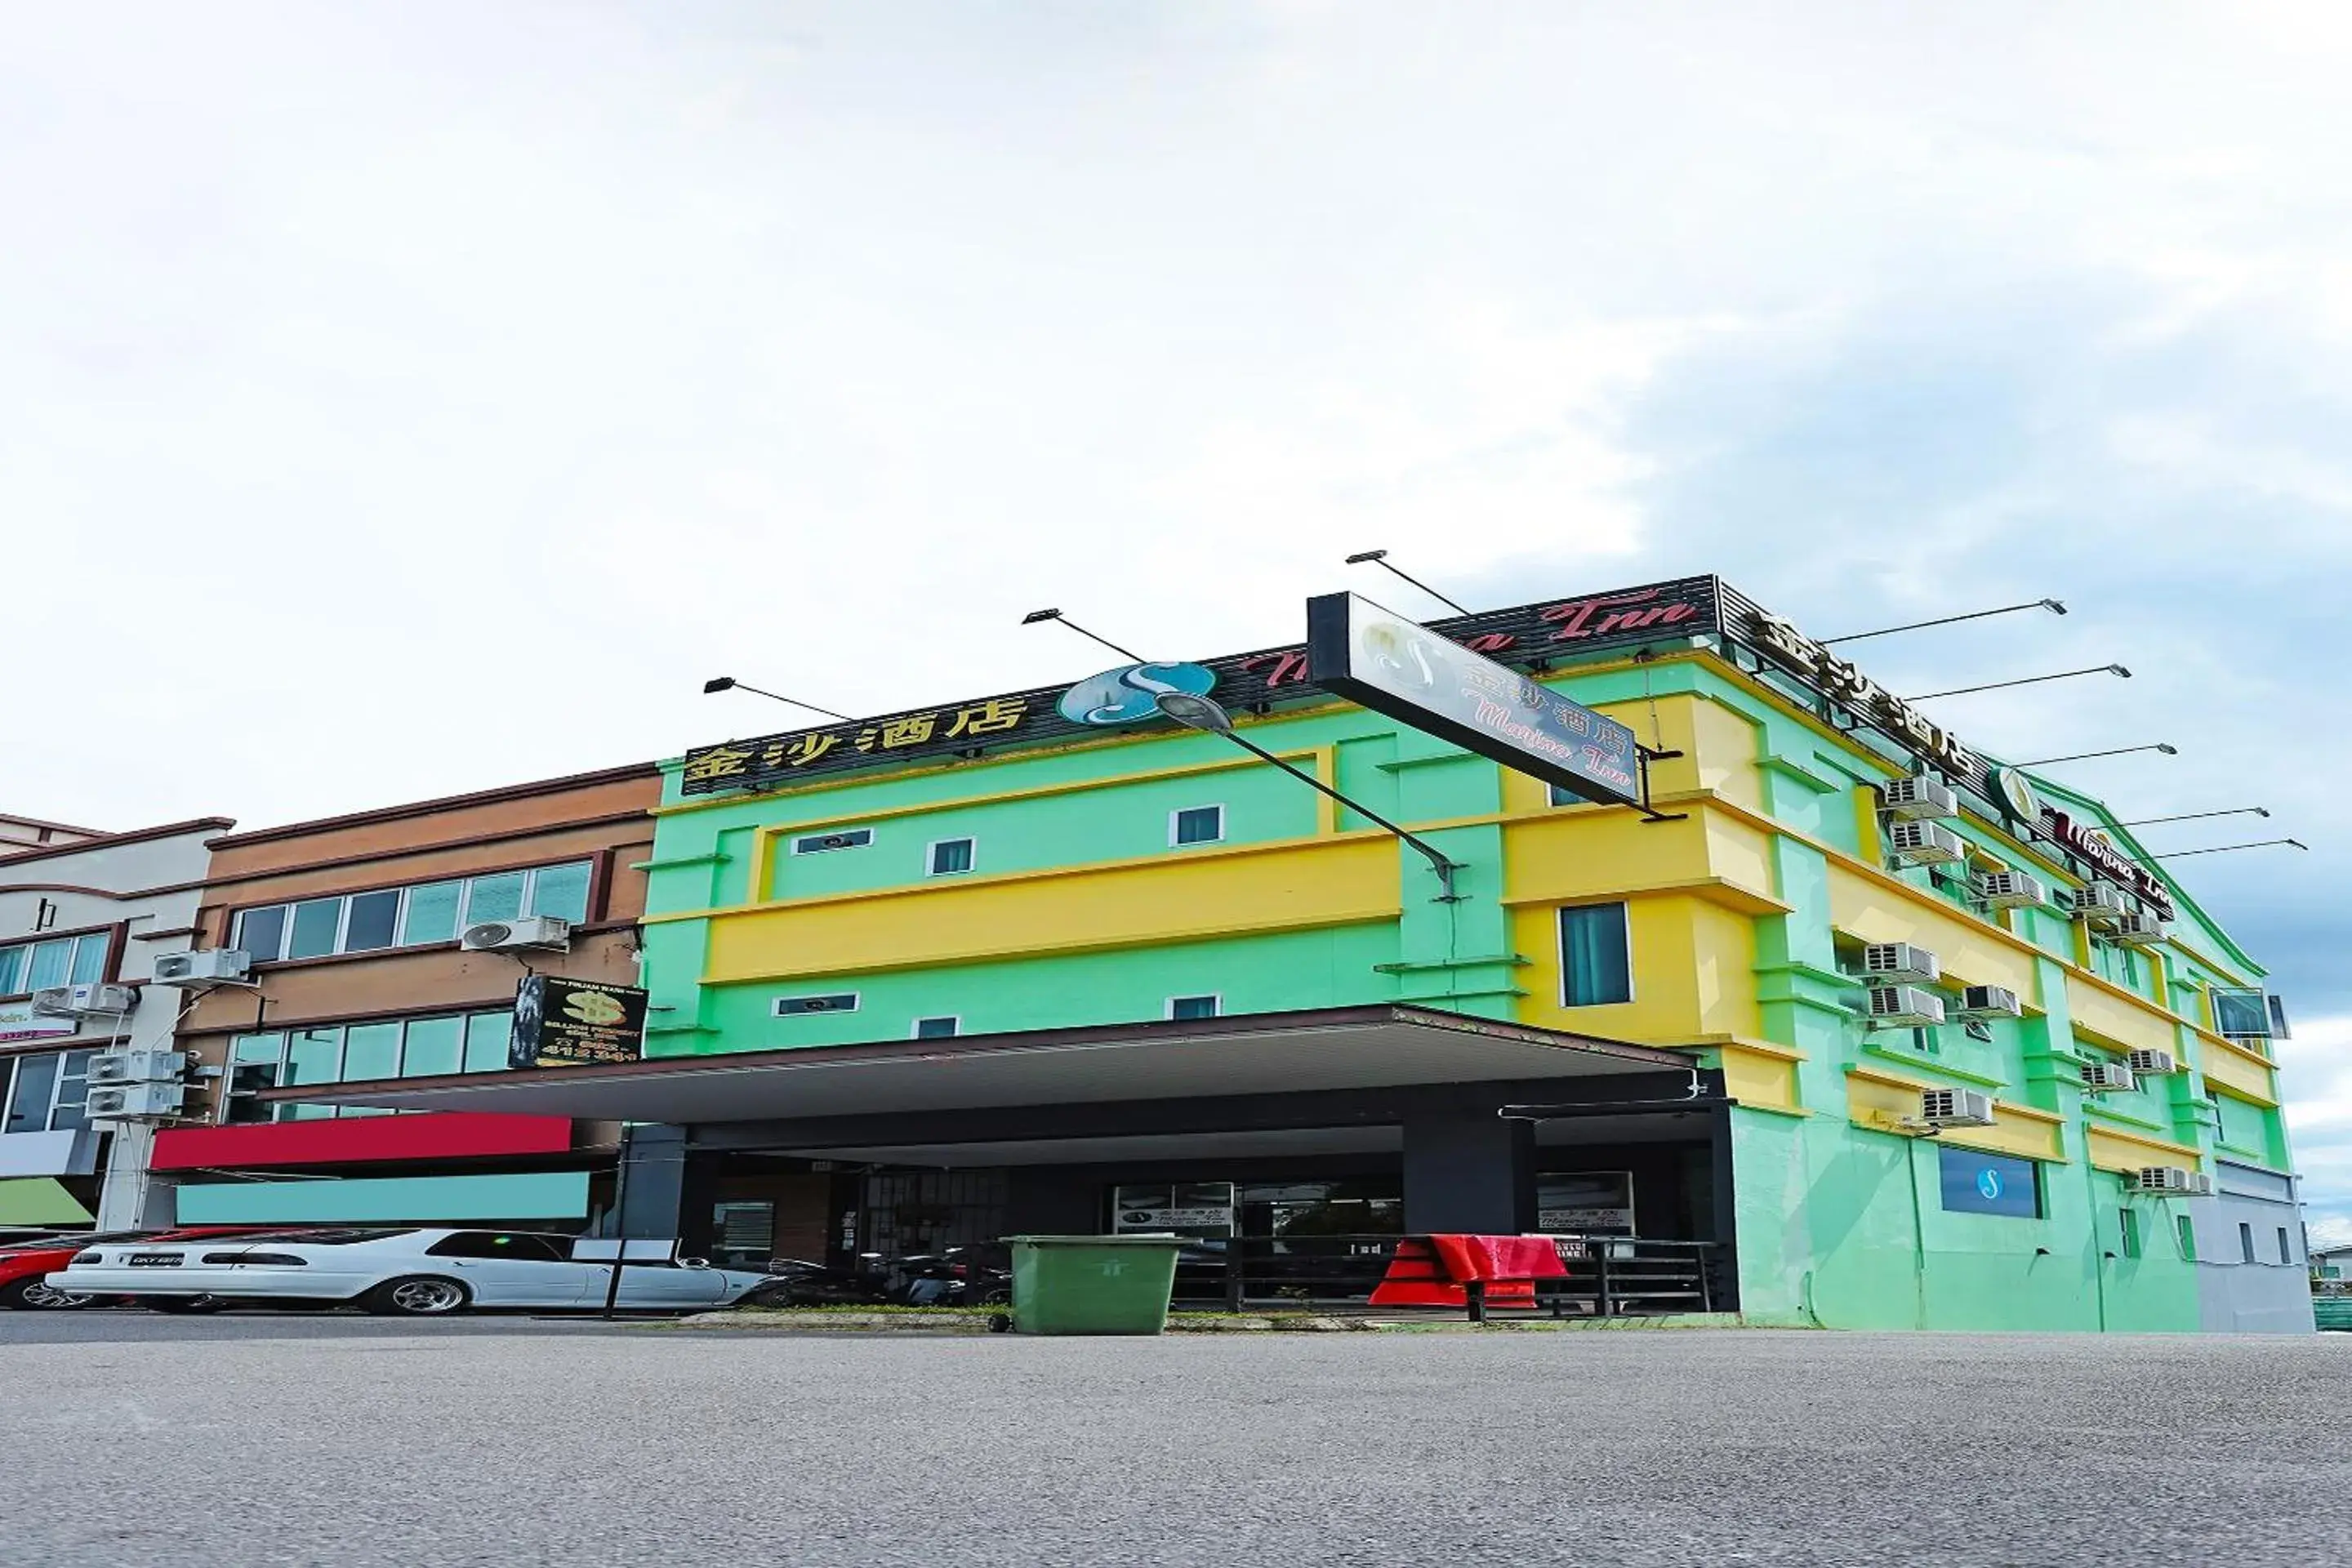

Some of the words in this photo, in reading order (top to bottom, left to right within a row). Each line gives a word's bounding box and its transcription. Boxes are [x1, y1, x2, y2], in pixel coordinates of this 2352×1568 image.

[1542, 588, 1696, 639] Inn
[684, 700, 1029, 782] 金沙酒店
[1461, 687, 1574, 760] Marina
[1582, 744, 1632, 786] Inn
[2045, 808, 2136, 881] Marina
